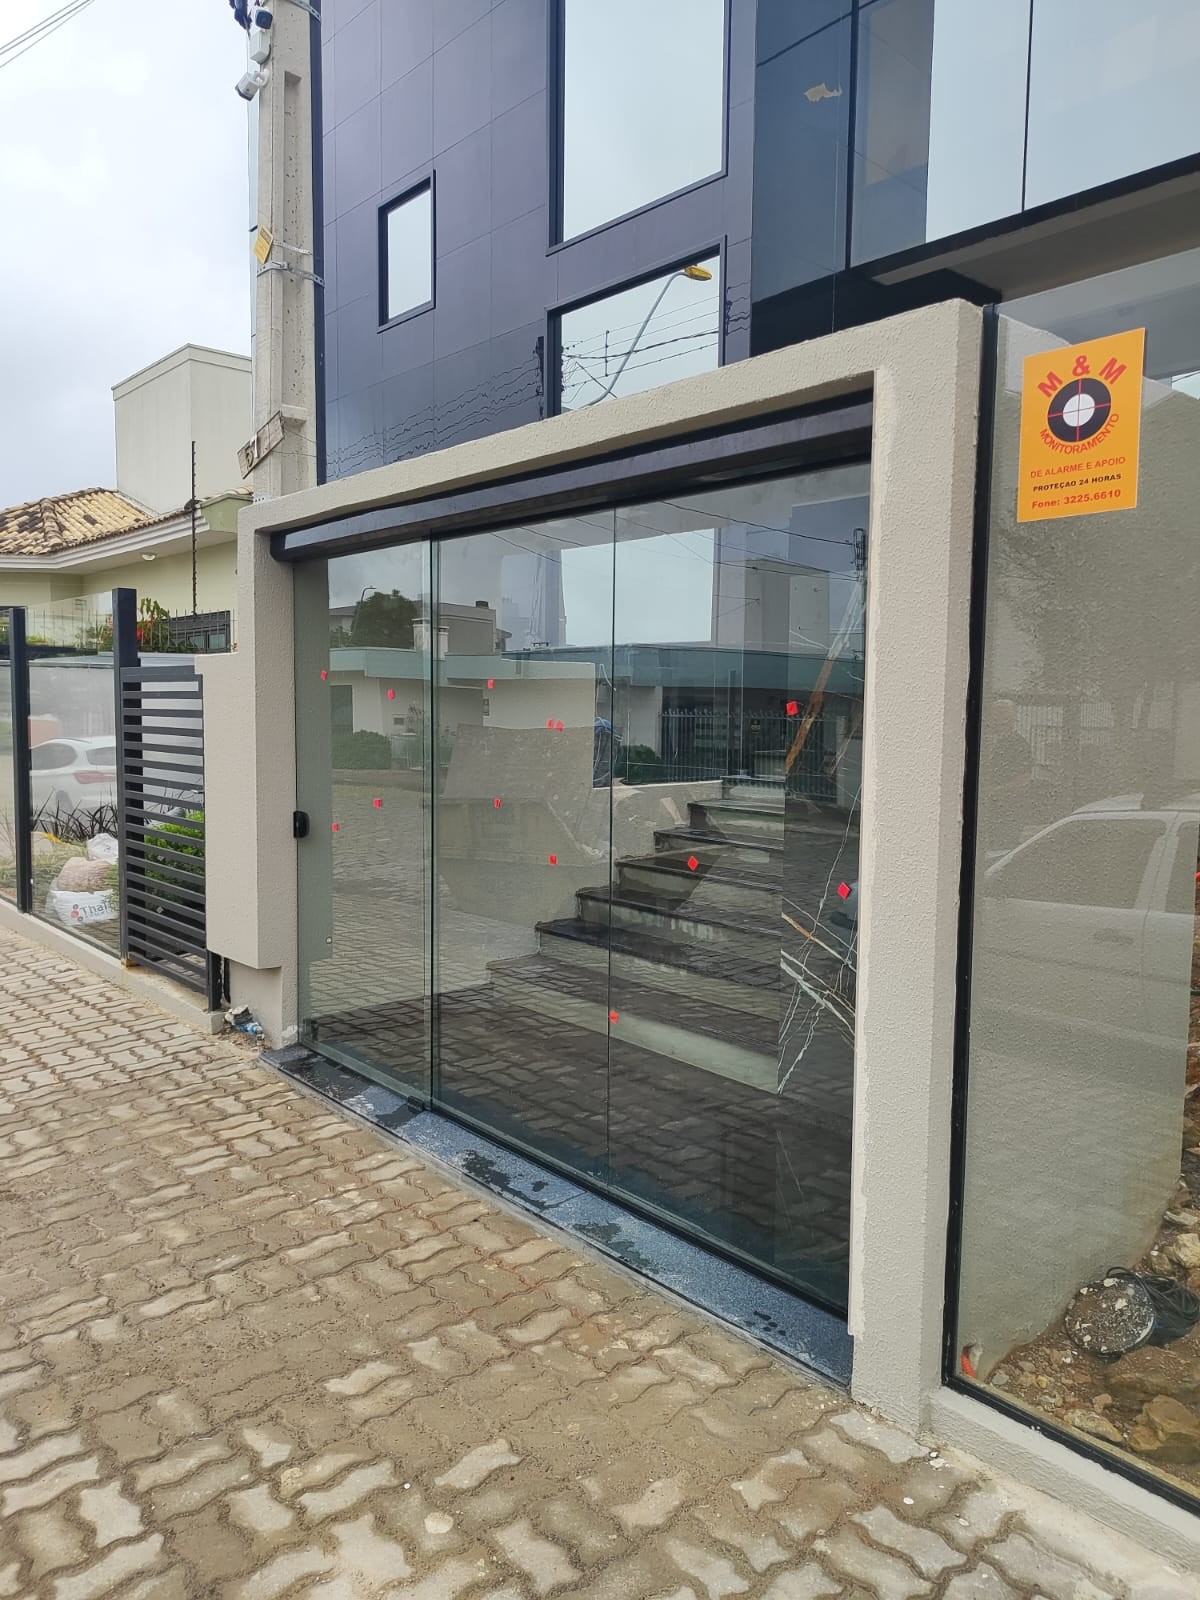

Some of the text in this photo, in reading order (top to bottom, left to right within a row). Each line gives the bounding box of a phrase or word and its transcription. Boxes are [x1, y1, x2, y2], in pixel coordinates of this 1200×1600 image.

[1038, 355, 1127, 398] M & M
[1040, 413, 1120, 455] MONITORAMENTO
[1030, 456, 1126, 479] DE ALARME E APOIO
[1078, 478, 1089, 486] 24
[1091, 474, 1122, 484] HORAS
[1032, 499, 1061, 510] Fone:
